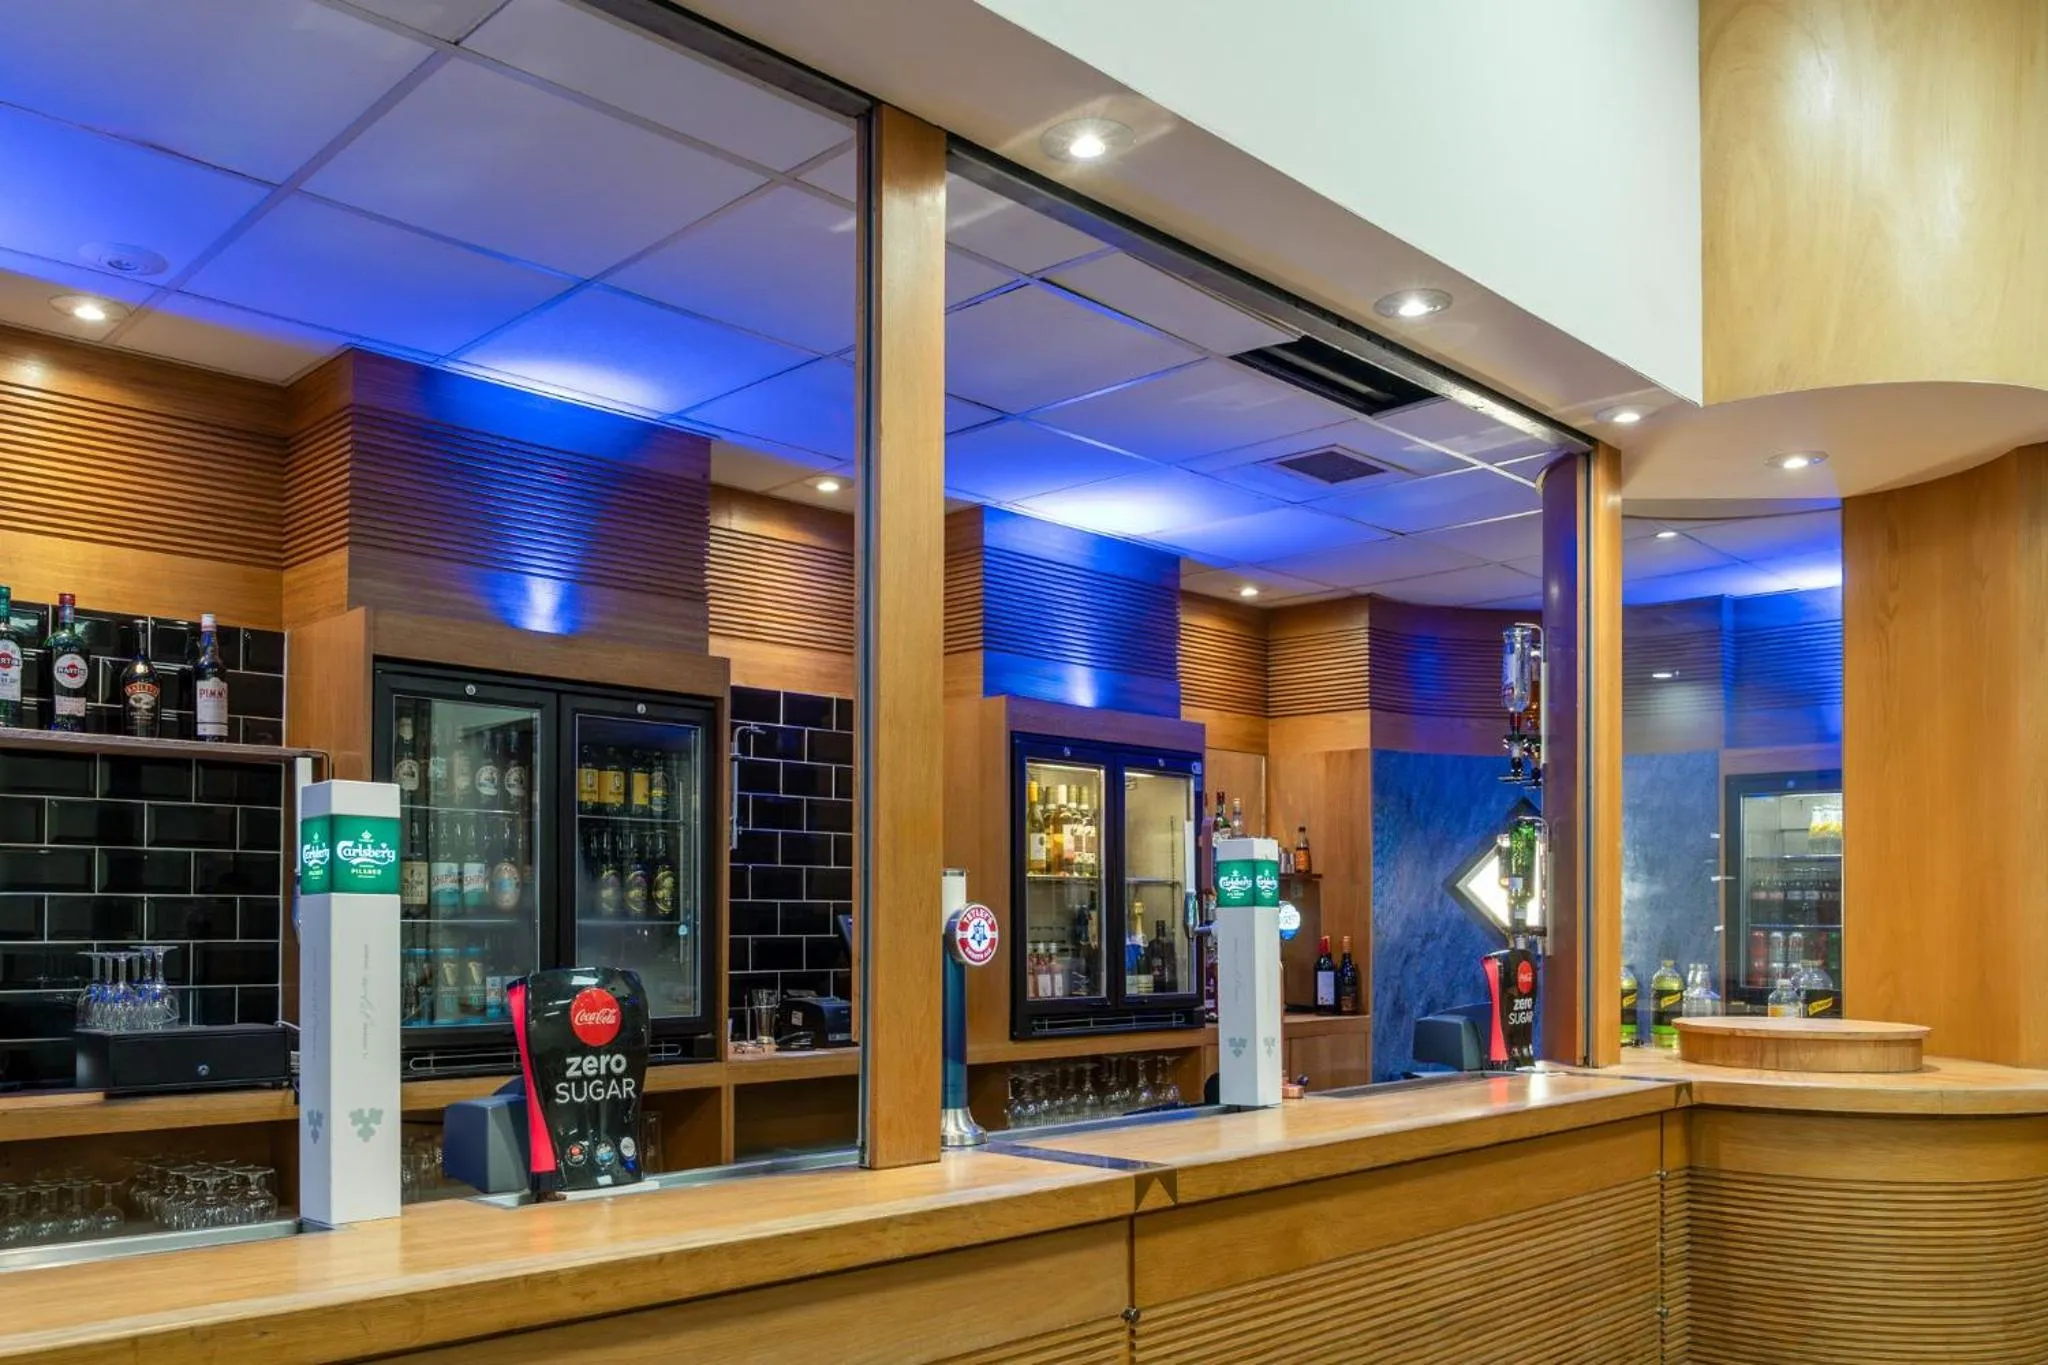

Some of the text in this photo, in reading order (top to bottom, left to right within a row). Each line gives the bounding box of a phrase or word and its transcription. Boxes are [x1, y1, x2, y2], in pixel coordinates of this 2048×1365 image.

[337, 840, 396, 865] Carlsberg
[575, 1008, 617, 1025] Coca-Cola
[565, 1053, 627, 1078] zero
[555, 1078, 636, 1104] SUGAR
